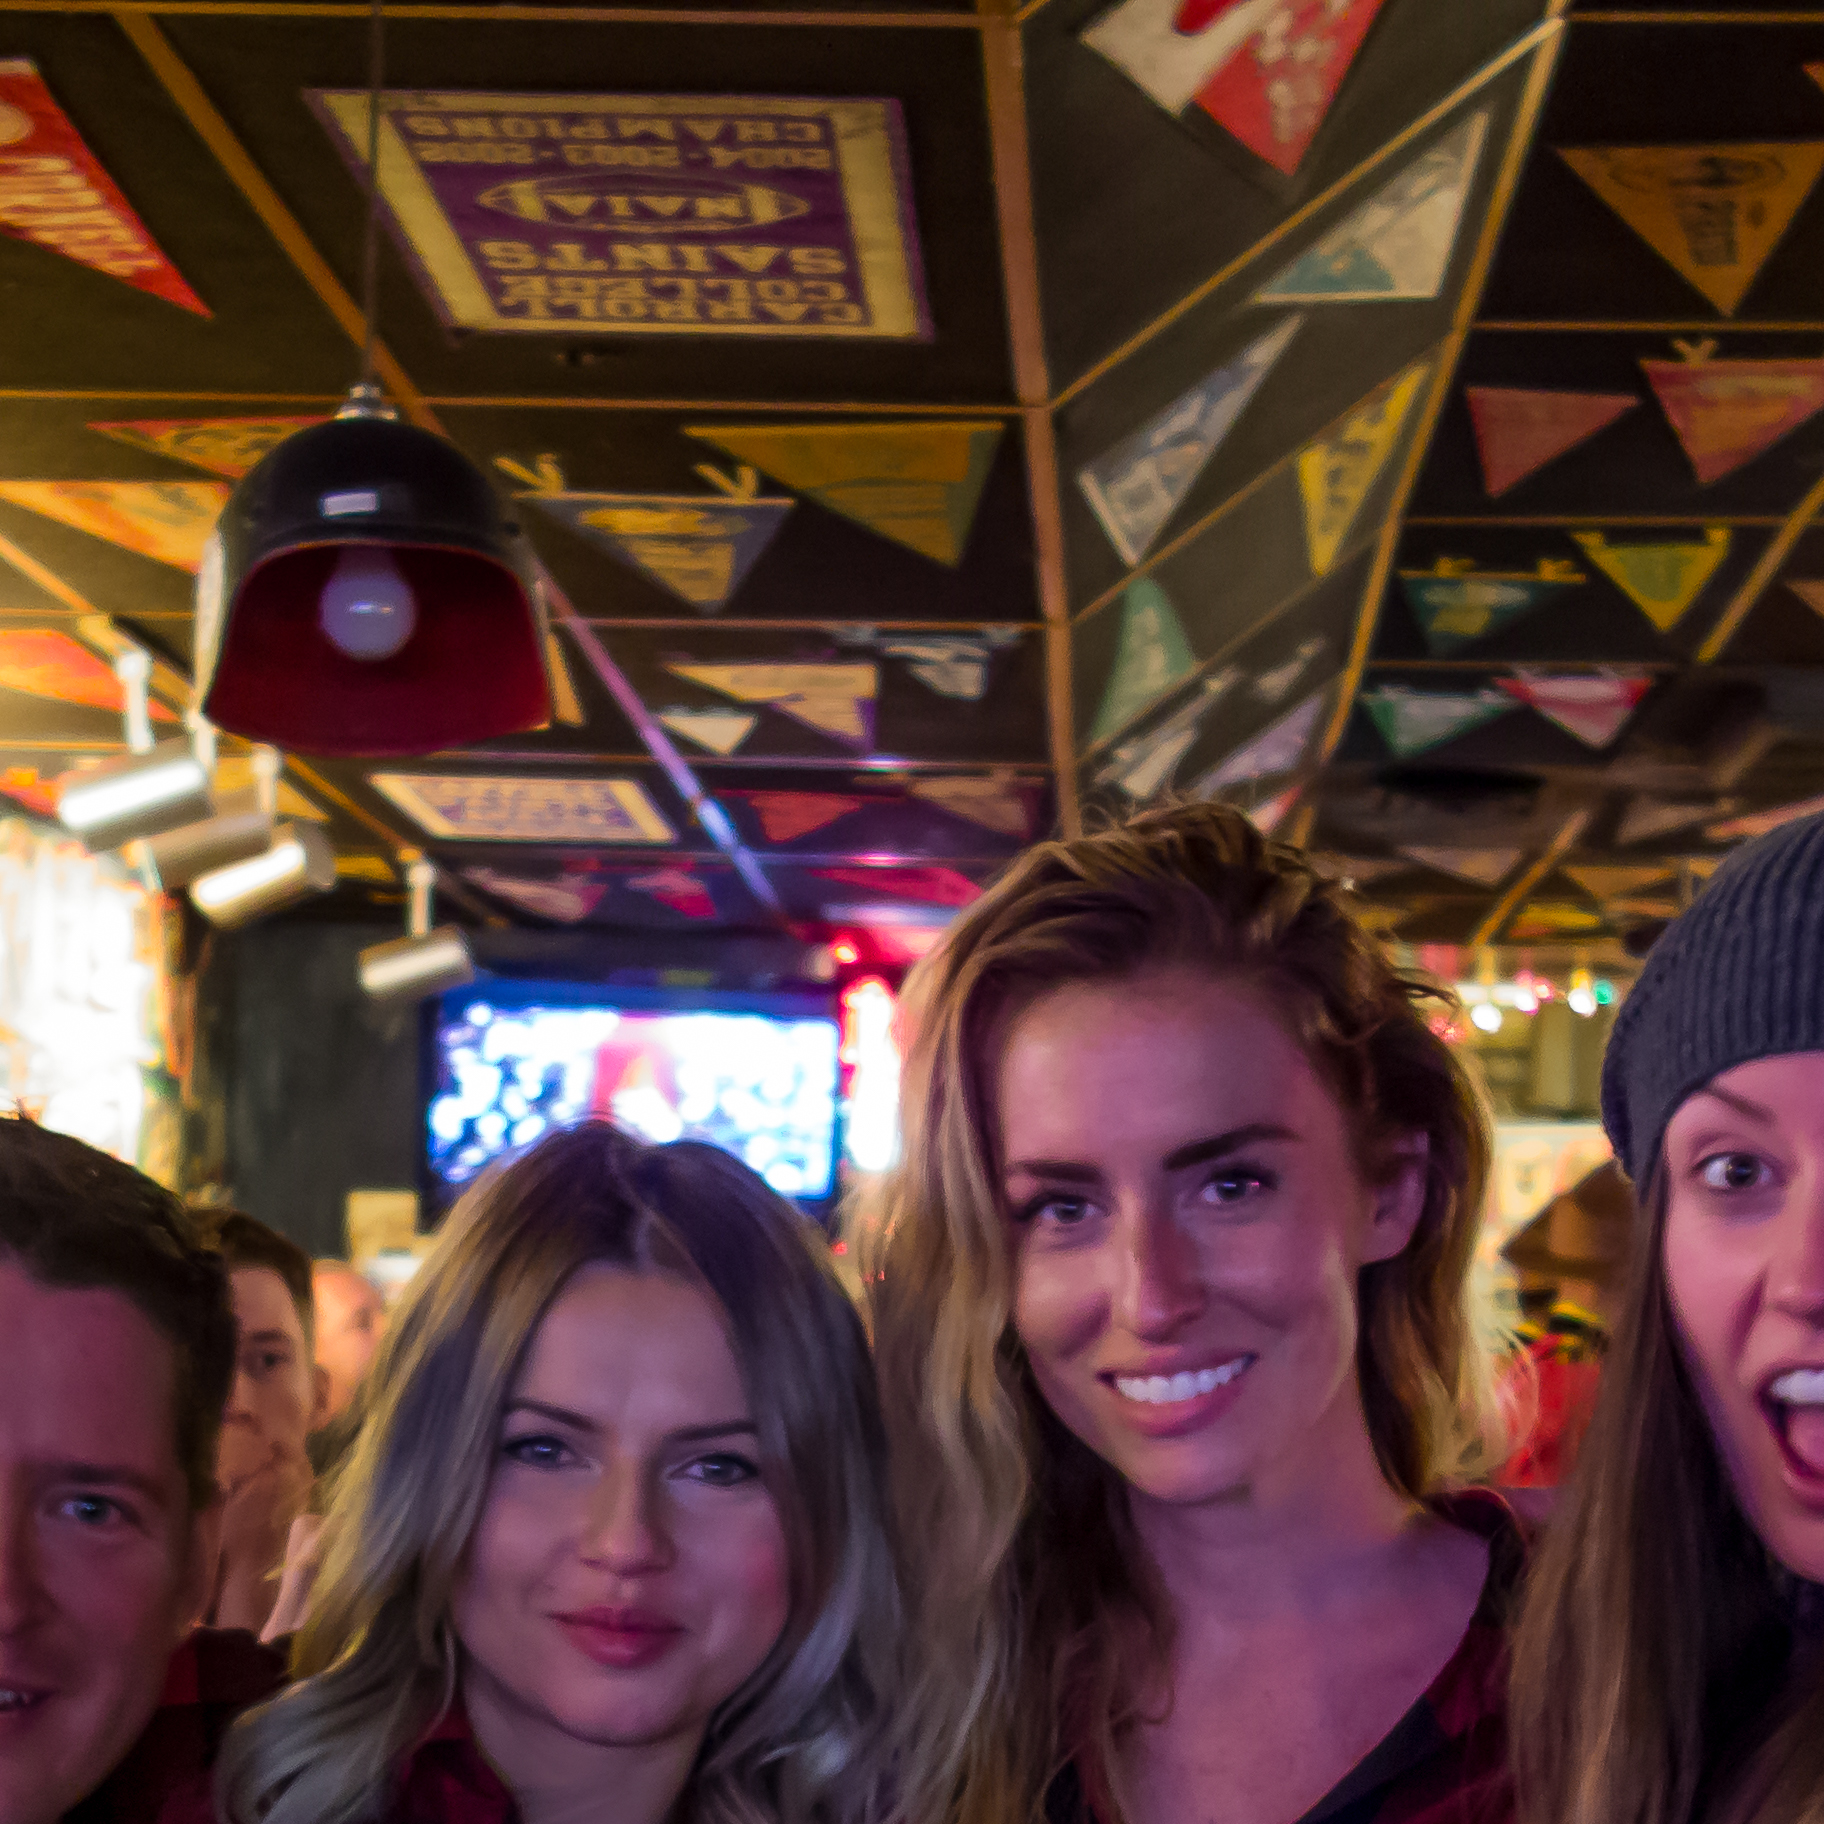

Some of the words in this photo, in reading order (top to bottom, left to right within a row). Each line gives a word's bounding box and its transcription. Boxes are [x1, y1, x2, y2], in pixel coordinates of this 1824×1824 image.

[405, 117, 823, 141] CHAMPIONS
[544, 195, 745, 217] NAIA
[479, 241, 847, 274] SAINTS
[501, 275, 847, 300] COLLEGE
[499, 299, 862, 322] CARROLL
